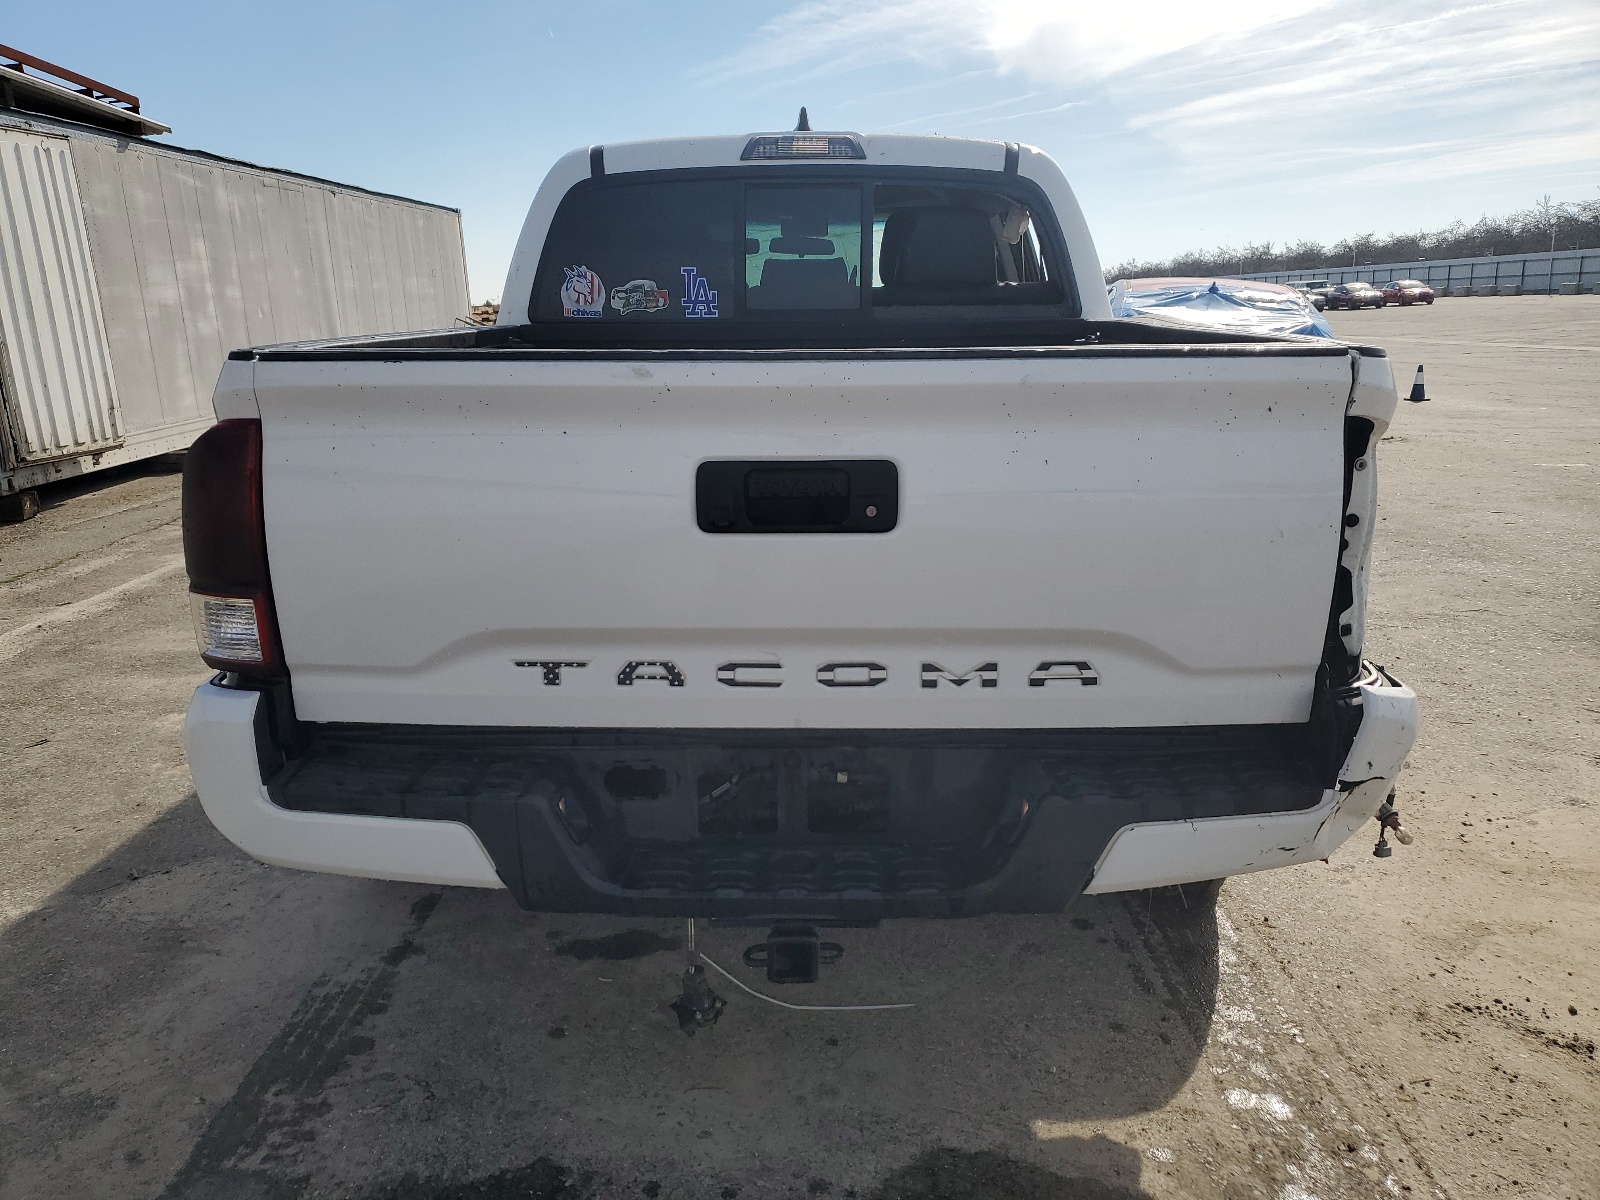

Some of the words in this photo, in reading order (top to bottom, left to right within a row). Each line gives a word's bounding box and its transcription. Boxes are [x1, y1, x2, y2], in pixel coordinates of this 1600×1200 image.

[680, 266, 718, 318] LA
[753, 479, 840, 496] TOYOTA
[512, 659, 1098, 688] TACOMA
